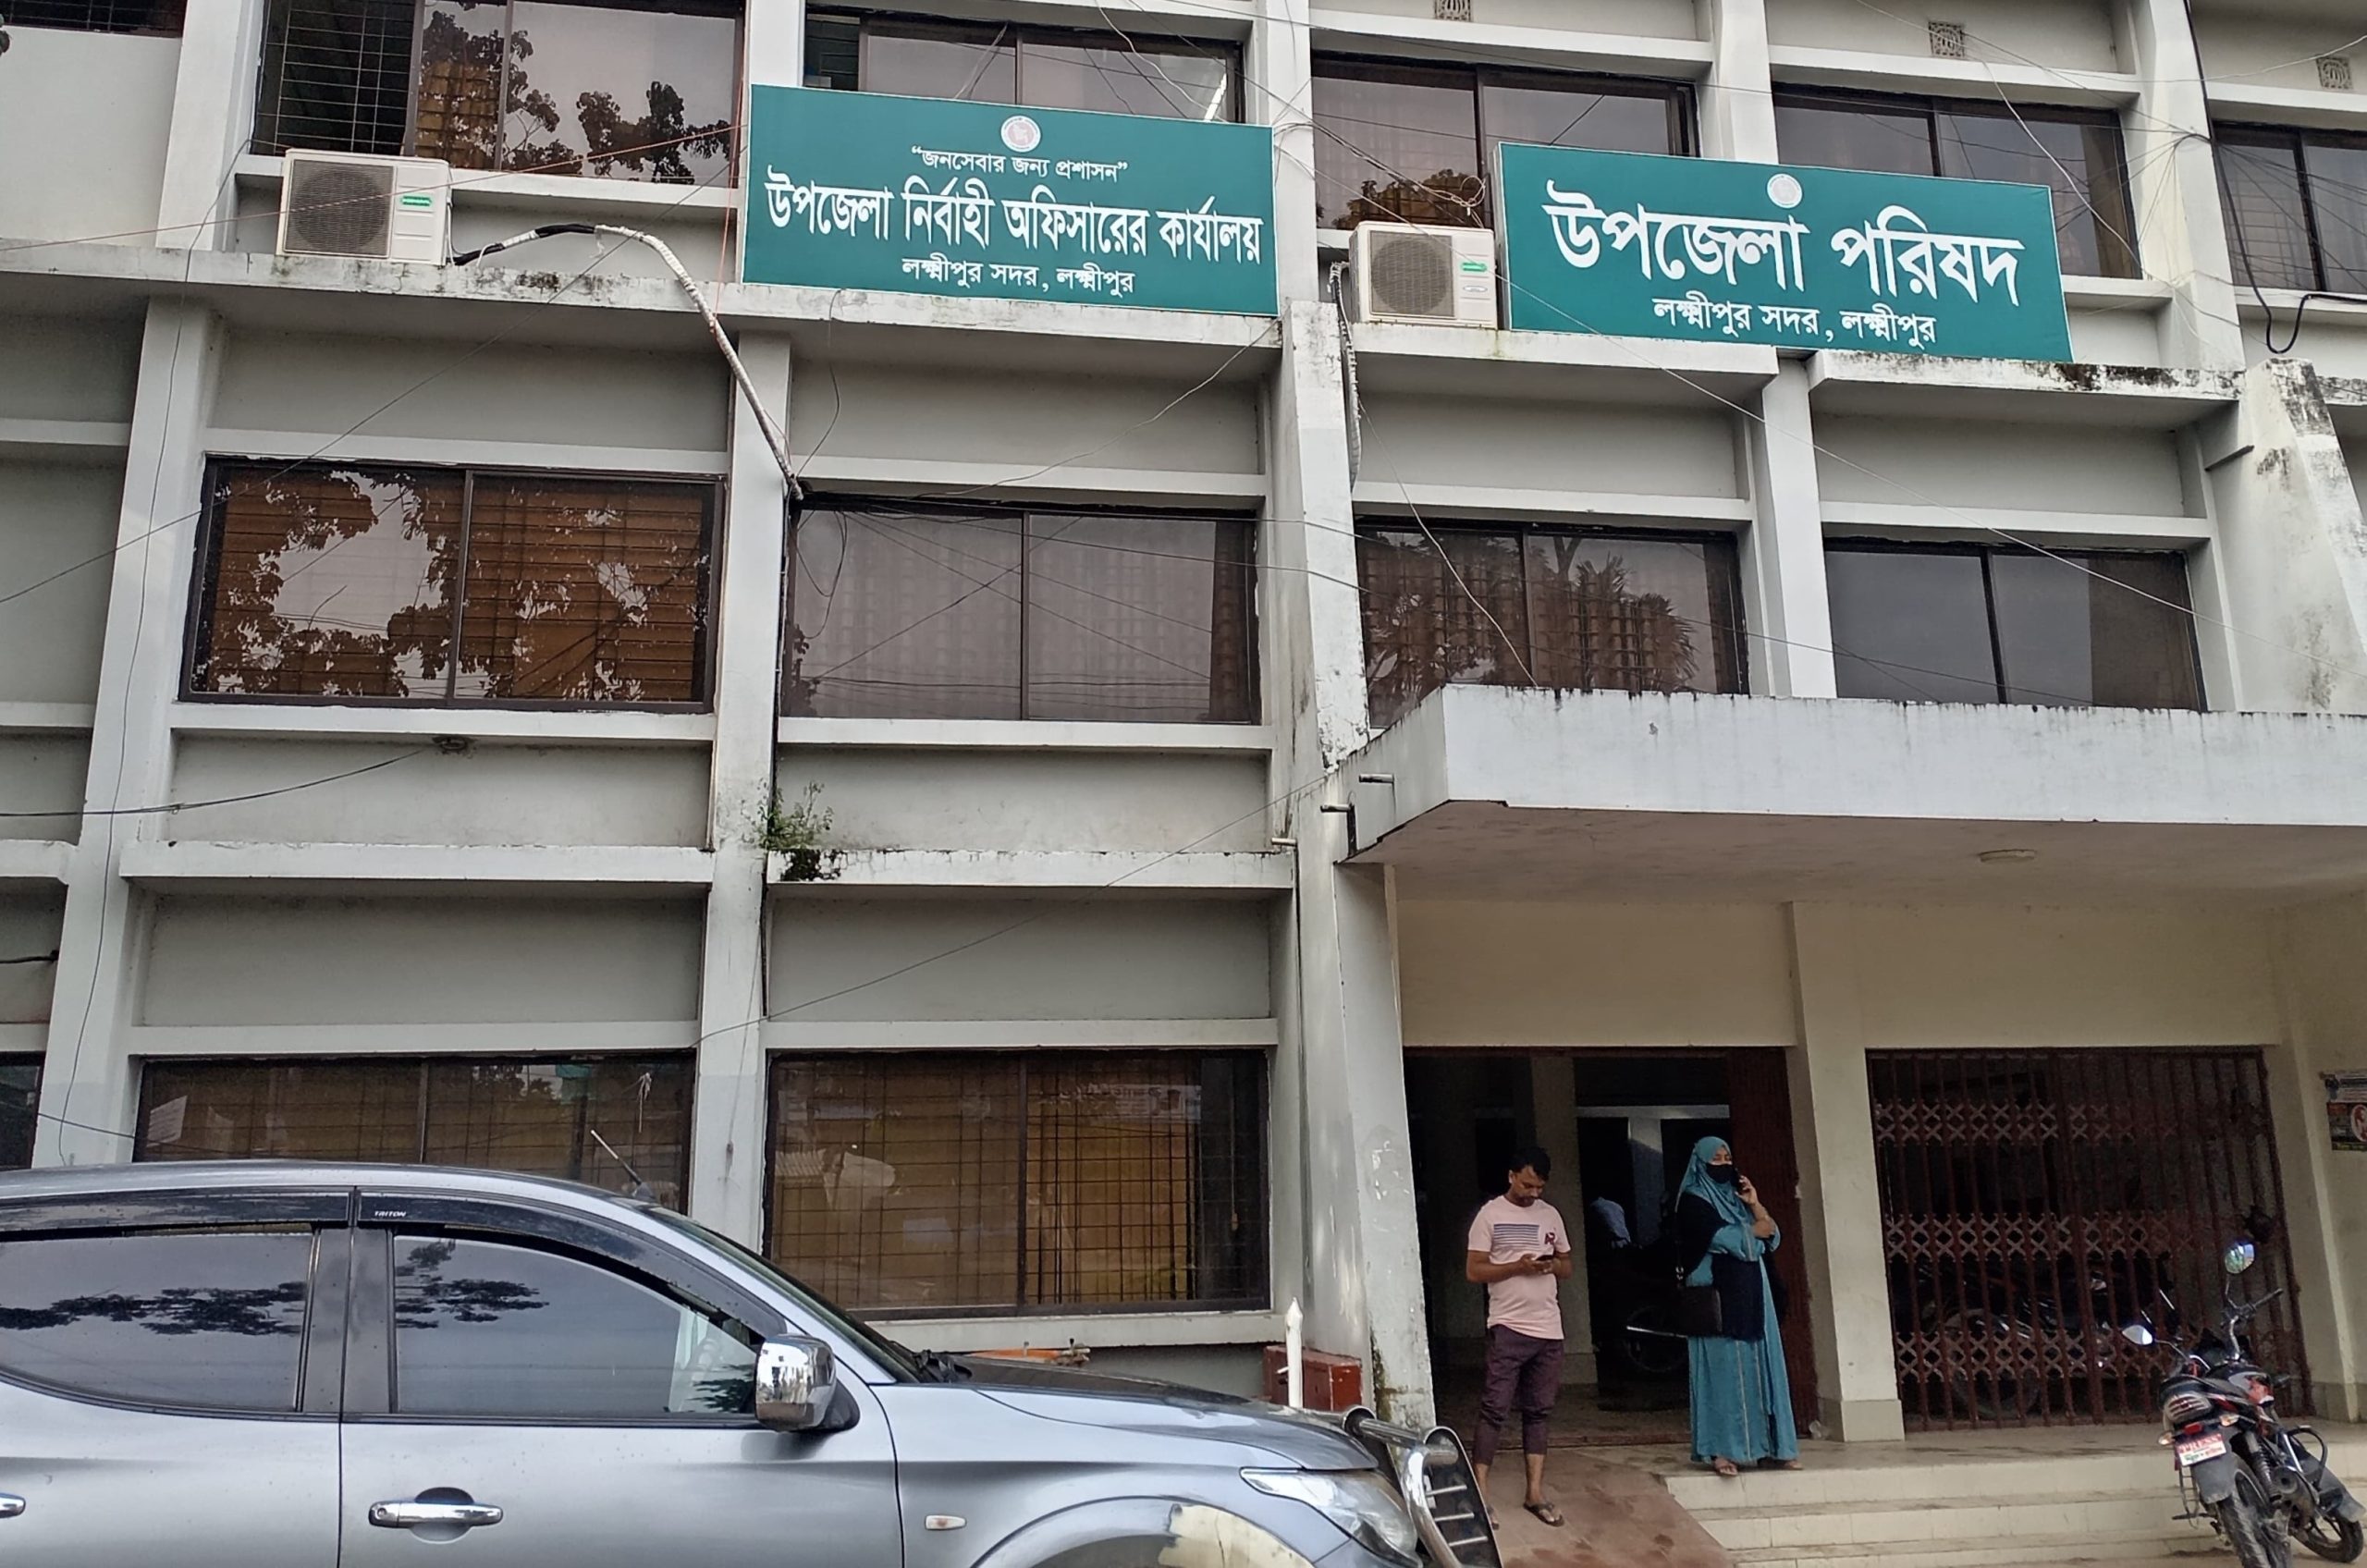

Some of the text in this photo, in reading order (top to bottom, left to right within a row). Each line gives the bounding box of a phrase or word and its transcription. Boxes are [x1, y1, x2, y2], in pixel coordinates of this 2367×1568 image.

[1010, 156, 1051, 178] জন্য
[764, 165, 1263, 264] উপজেলা নির্বাহী অফিসারের কার্যালয়
[1541, 180, 2025, 307] উপজেলা পরিষদ
[902, 252, 984, 288] লক্ষ্মীপুর
[1056, 263, 1134, 297] লক্ষ্মীপুর
[1652, 289, 1752, 337] লক্ষ্মীপুর
[1839, 302, 1937, 349] লক্ষ্মীপুর
[374, 1209, 407, 1218] TRITON
